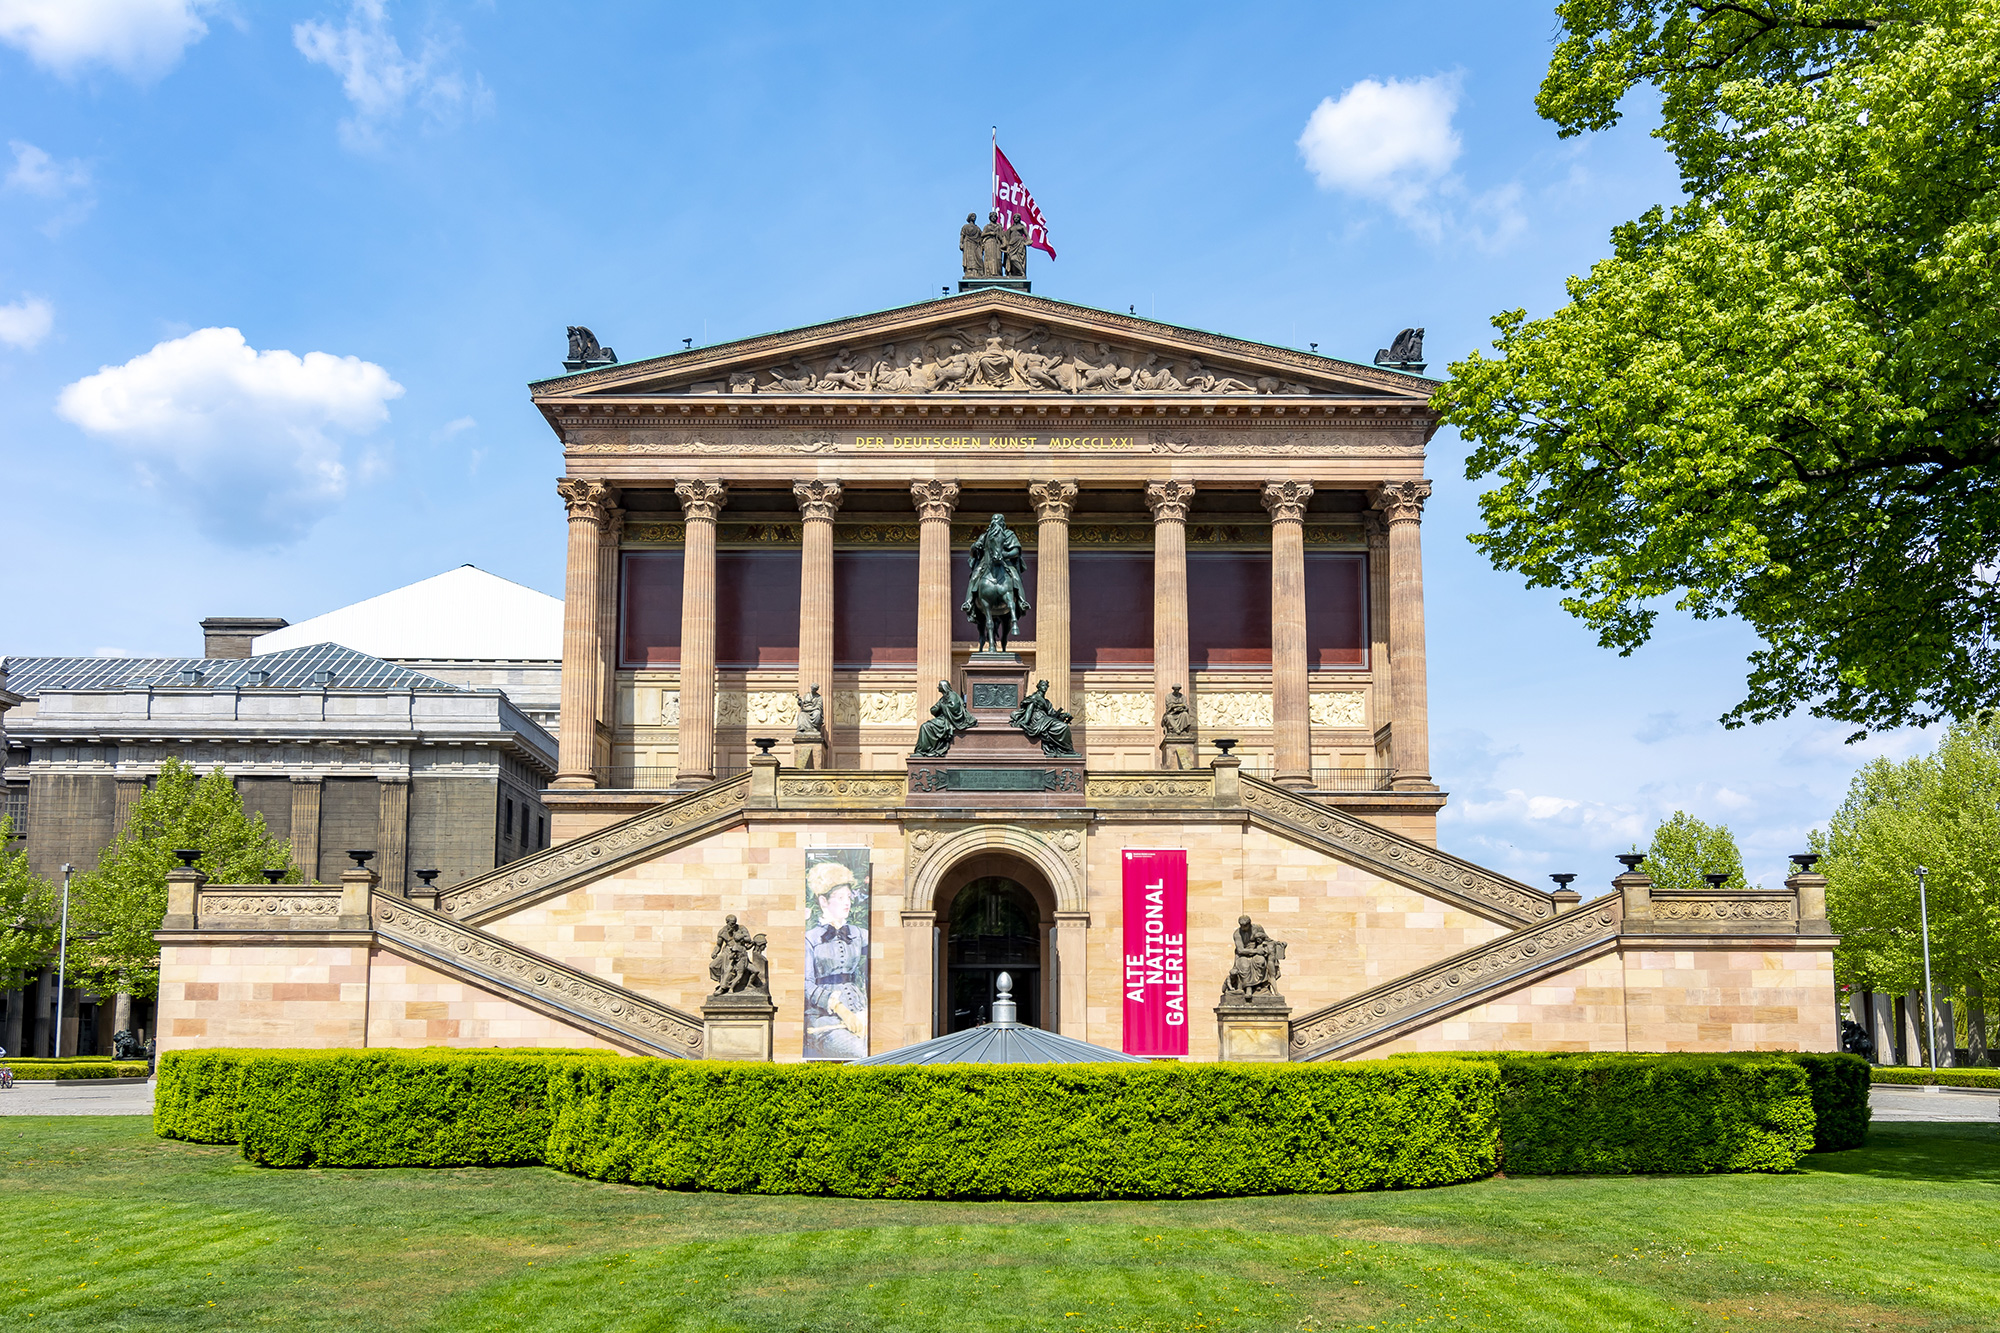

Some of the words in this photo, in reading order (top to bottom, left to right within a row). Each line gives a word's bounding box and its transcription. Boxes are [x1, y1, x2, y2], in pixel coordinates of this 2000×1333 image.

[856, 436, 885, 448] DER
[893, 436, 981, 448] DEUTSCHEN
[989, 436, 1037, 448] KUNST
[1049, 436, 1134, 448] MDCCCLXXI
[1145, 878, 1164, 985] NATIONAL
[1126, 954, 1145, 1003] ALTE
[1165, 933, 1184, 1026] GALERIE
